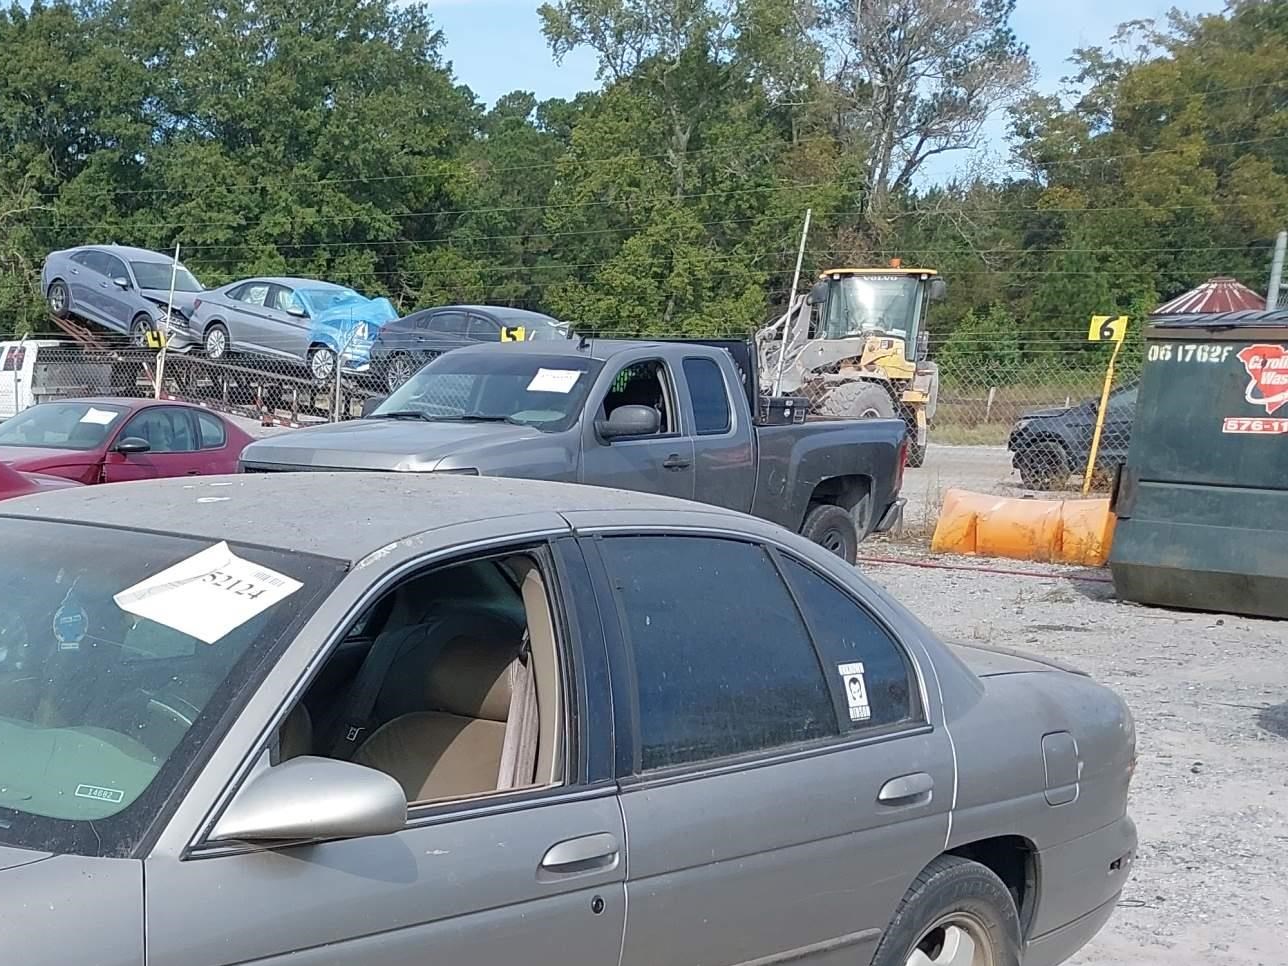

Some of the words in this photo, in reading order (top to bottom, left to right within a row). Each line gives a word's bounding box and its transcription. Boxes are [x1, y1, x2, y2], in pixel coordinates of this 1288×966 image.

[505, 326, 518, 342] 5
[1100, 312, 1120, 340] 6
[151, 330, 162, 347] 4
